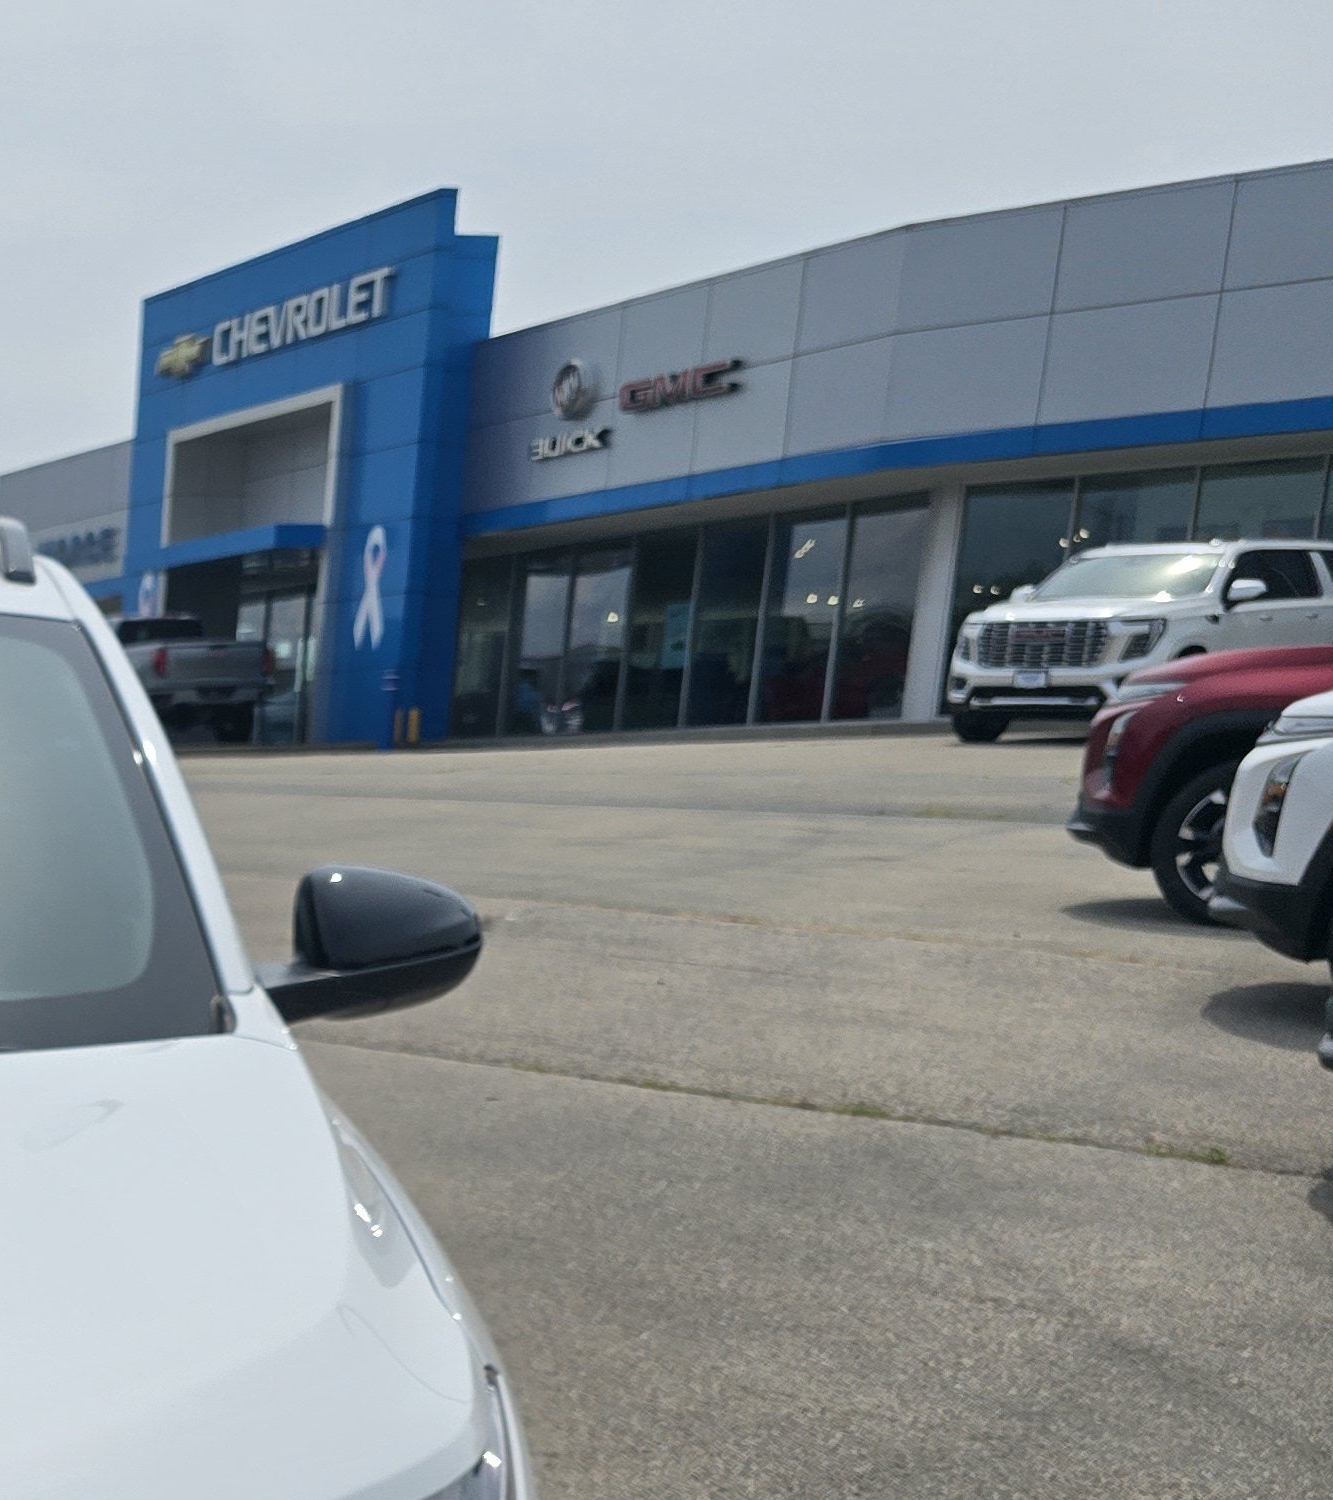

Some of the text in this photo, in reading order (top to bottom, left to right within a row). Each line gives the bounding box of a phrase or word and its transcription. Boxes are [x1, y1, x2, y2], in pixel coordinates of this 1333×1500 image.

[211, 267, 395, 367] CHEVROLET
[619, 359, 741, 414] GMC
[531, 428, 611, 461] BUICK
